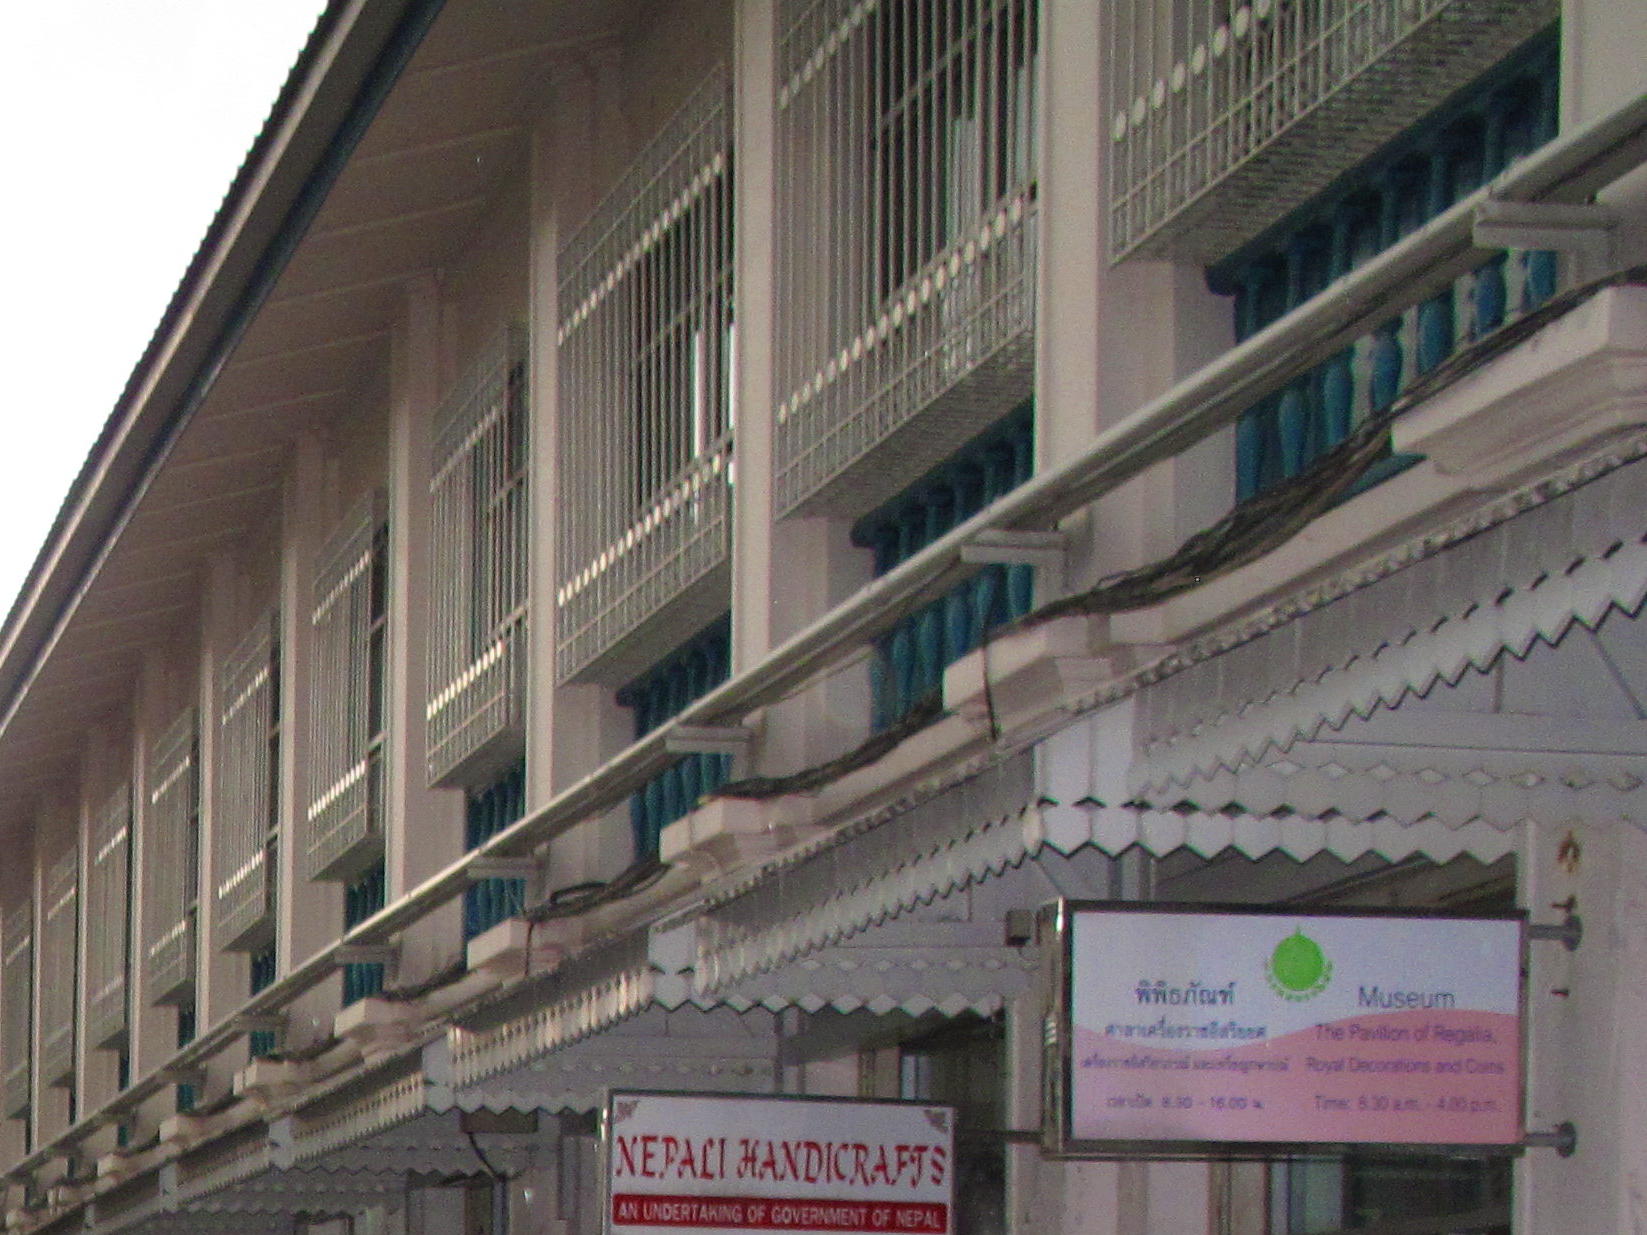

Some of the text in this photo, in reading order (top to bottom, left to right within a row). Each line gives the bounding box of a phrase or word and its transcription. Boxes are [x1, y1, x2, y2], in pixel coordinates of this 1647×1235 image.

[1135, 978, 1235, 1005] พิพิธภัณฑ์
[1358, 985, 1455, 1009] Museum
[1315, 1023, 1345, 1041] The
[1349, 1023, 1410, 1042] Pavilion
[1414, 1023, 1431, 1041] of
[1305, 1056, 1505, 1075] Royal Decorations and Coins
[615, 1135, 946, 1188] NEPALI HANDICRAFTS
[618, 1202, 940, 1228] AN UNDERTAKING OF GOVERNMENT OF NEPAL
